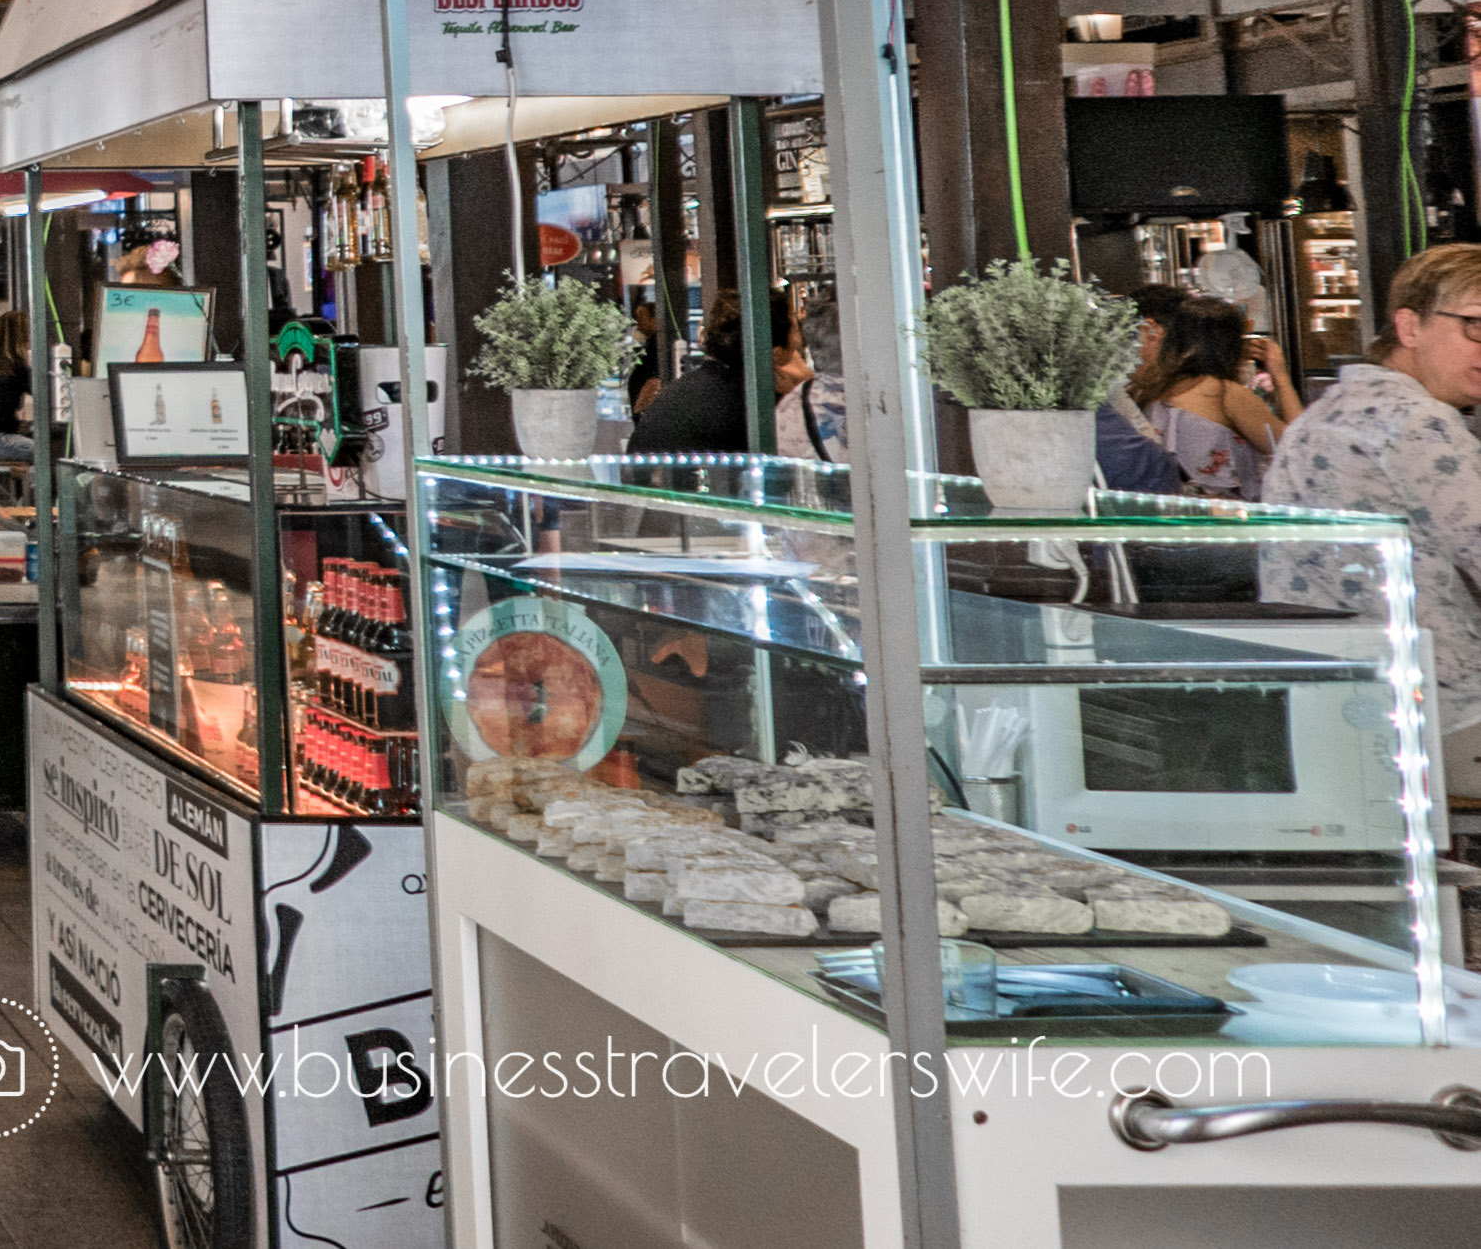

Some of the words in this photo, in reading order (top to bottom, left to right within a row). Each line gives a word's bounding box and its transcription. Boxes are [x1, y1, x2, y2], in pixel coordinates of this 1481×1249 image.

[442, 20, 484, 38] Tequila
[488, 19, 549, 35] Flvoured
[550, 20, 580, 35] Beer
[110, 292, 135, 307] 3€
[59, 755, 120, 843] inspiró
[153, 828, 183, 891] DE
[185, 850, 233, 926] SOL
[170, 792, 224, 848] ALEMÁN
[138, 880, 237, 985] CERVECERÍA
